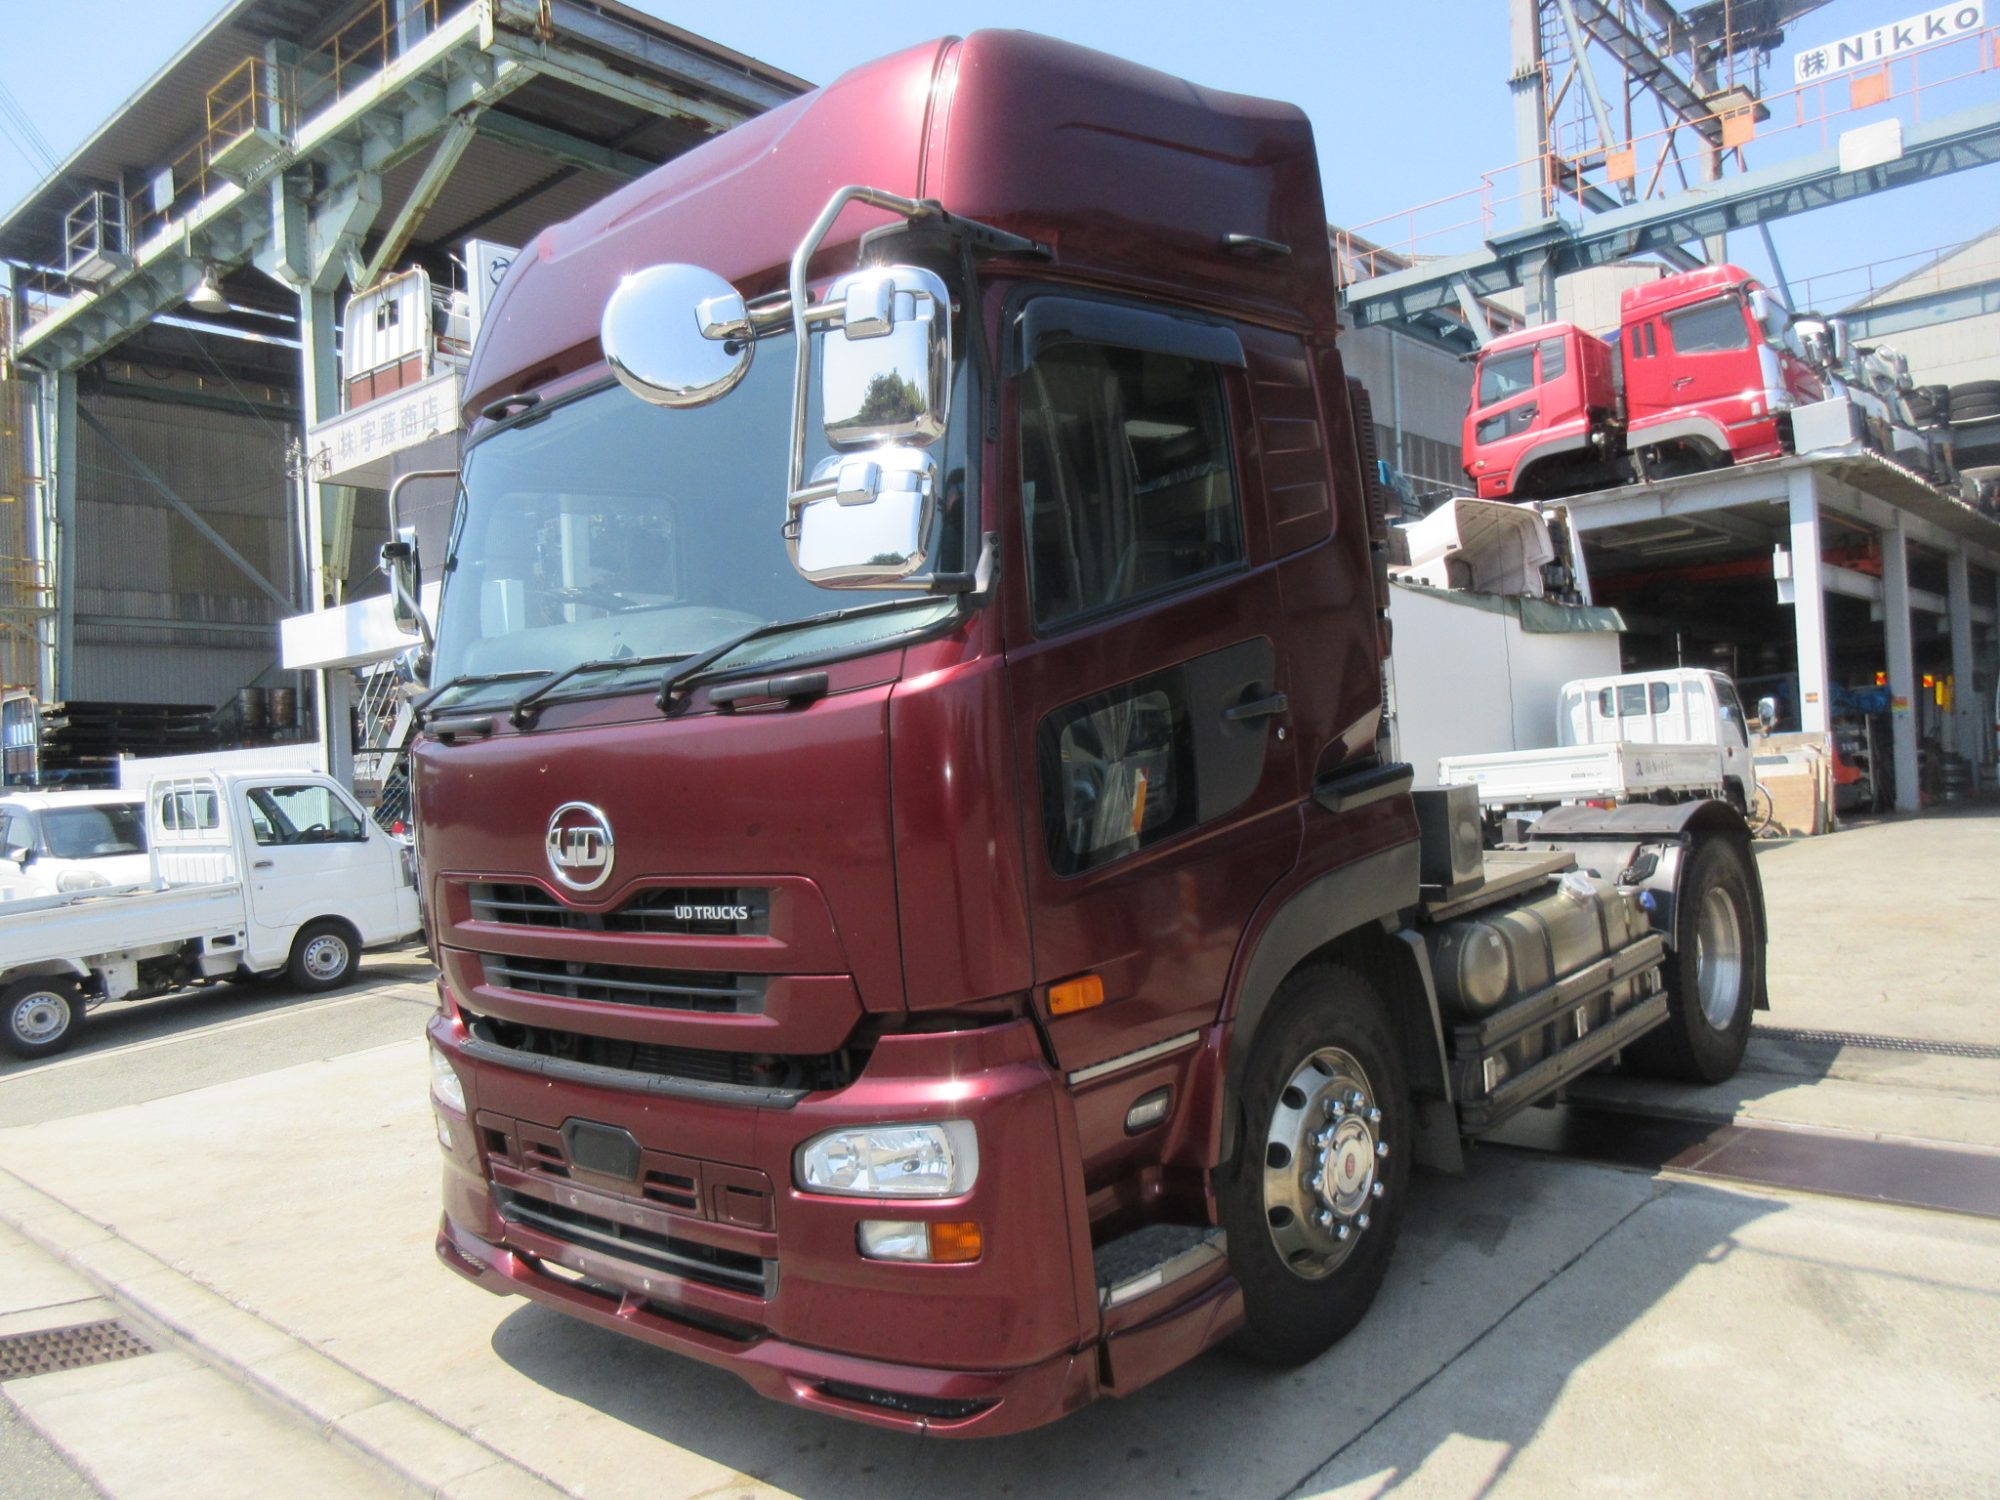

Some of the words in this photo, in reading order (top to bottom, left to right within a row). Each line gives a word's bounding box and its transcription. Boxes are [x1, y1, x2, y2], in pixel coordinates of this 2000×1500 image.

[550, 826, 609, 867] UD
[674, 905, 692, 919] UD
[694, 905, 748, 920] TRUCKS
